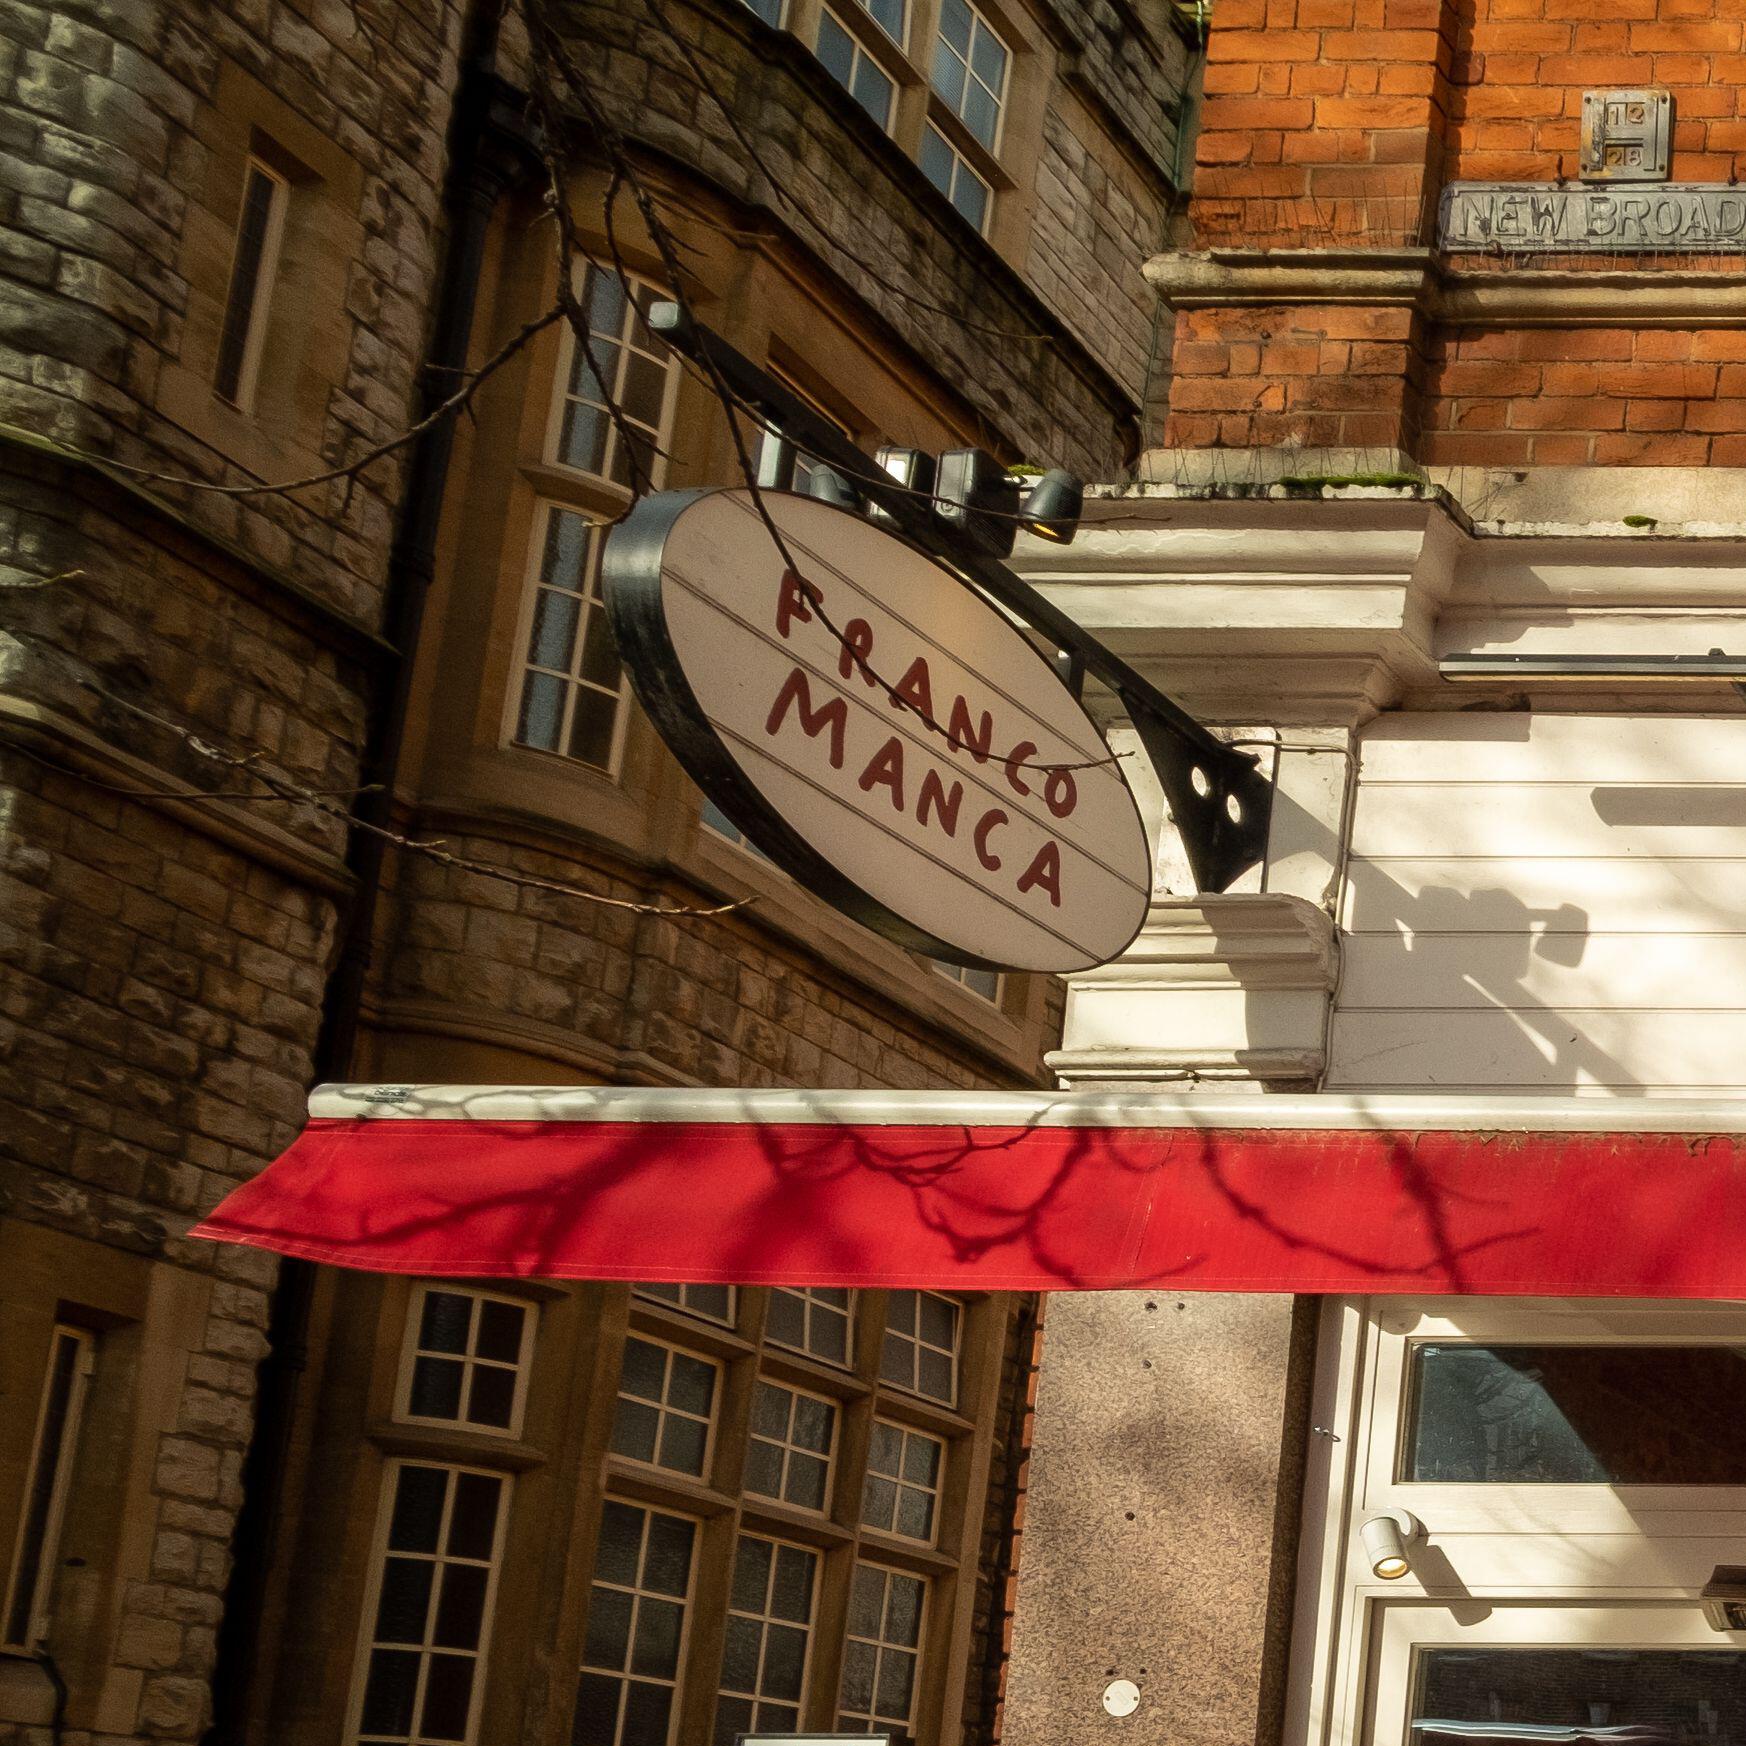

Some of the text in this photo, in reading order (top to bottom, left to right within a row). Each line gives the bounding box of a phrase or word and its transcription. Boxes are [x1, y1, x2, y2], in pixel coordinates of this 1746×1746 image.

[1461, 194, 1568, 237] NEW
[765, 666, 1061, 908] MANCA
[775, 567, 1078, 819] FRANCO
